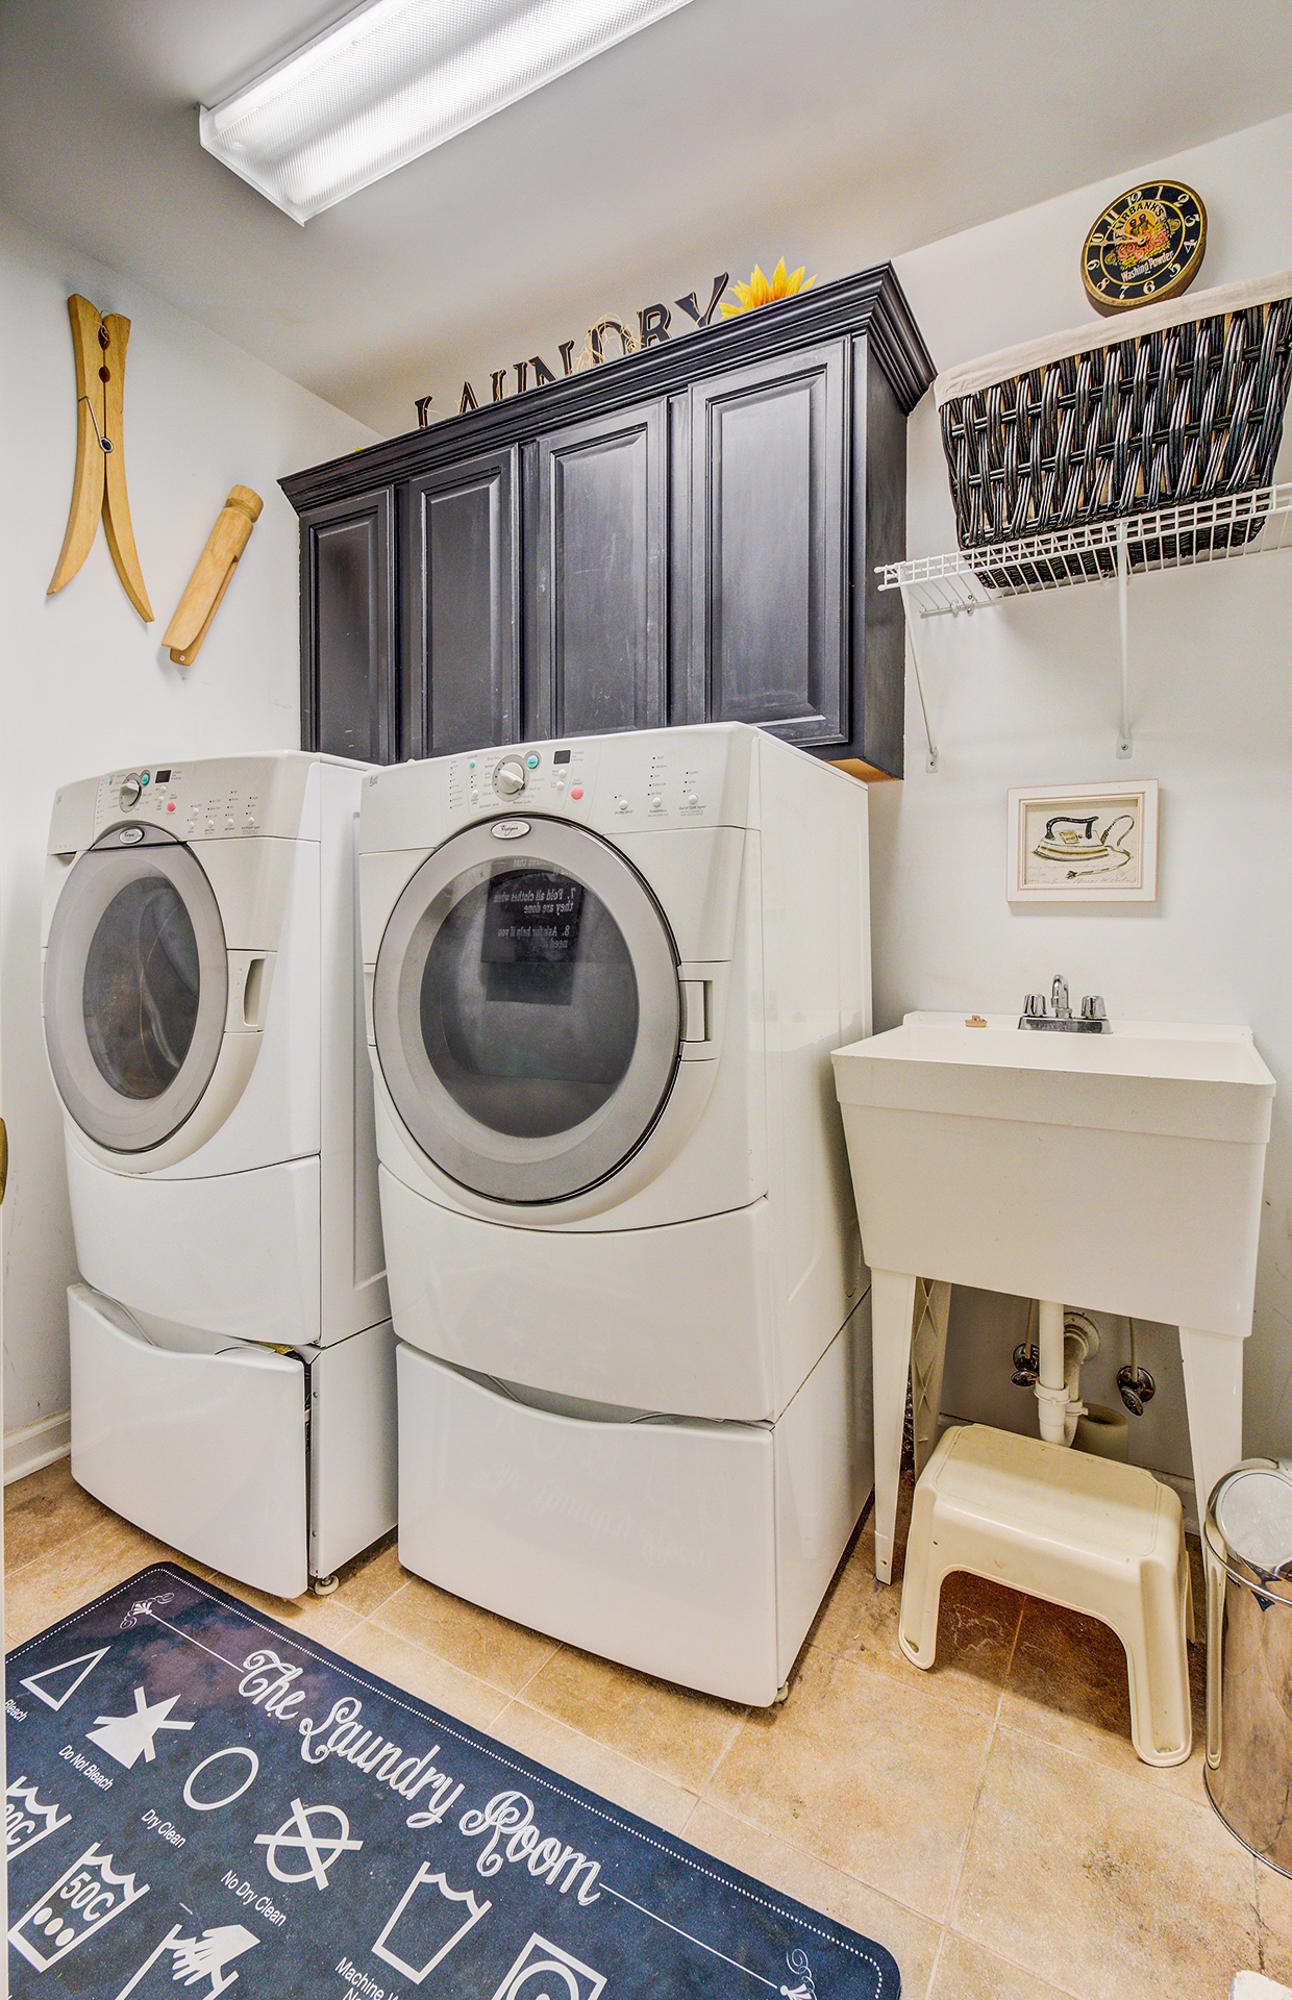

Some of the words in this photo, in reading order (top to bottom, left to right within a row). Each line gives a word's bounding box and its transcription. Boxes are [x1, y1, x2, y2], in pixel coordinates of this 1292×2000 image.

[1124, 190, 1143, 207] 12
[1153, 185, 1164, 200] 1
[1173, 193, 1189, 207] 2
[1103, 209, 1120, 225] 11
[1184, 213, 1200, 228] 3
[1117, 231, 1151, 259] GOD
[1134, 229, 1169, 262] DUST
[1183, 238, 1198, 254] 4
[1087, 259, 1101, 271] 9
[1120, 261, 1151, 282] Washing
[1148, 250, 1174, 270] Powder
[1167, 262, 1181, 278] 5
[1096, 277, 1110, 291] 8
[1119, 284, 1130, 300] 7
[1143, 280, 1156, 295] 6
[414, 271, 730, 429] LAUNDRY
[58, 1744, 74, 1760] Do
[70, 1753, 88, 1771] Not
[83, 1764, 114, 1791] Bleach
[238, 1650, 305, 1720] The
[299, 1697, 465, 1829] Laundry
[459, 1790, 601, 1905] Room
[6, 1803, 36, 1846] 0C
[141, 1808, 161, 1830] Dry
[158, 1821, 186, 1848] Clean
[60, 1871, 115, 1922] 50C
[220, 1870, 239, 1889] No
[235, 1881, 258, 1905] Dry
[254, 1896, 287, 1927] Clean
[334, 1956, 385, 2000] Machine
